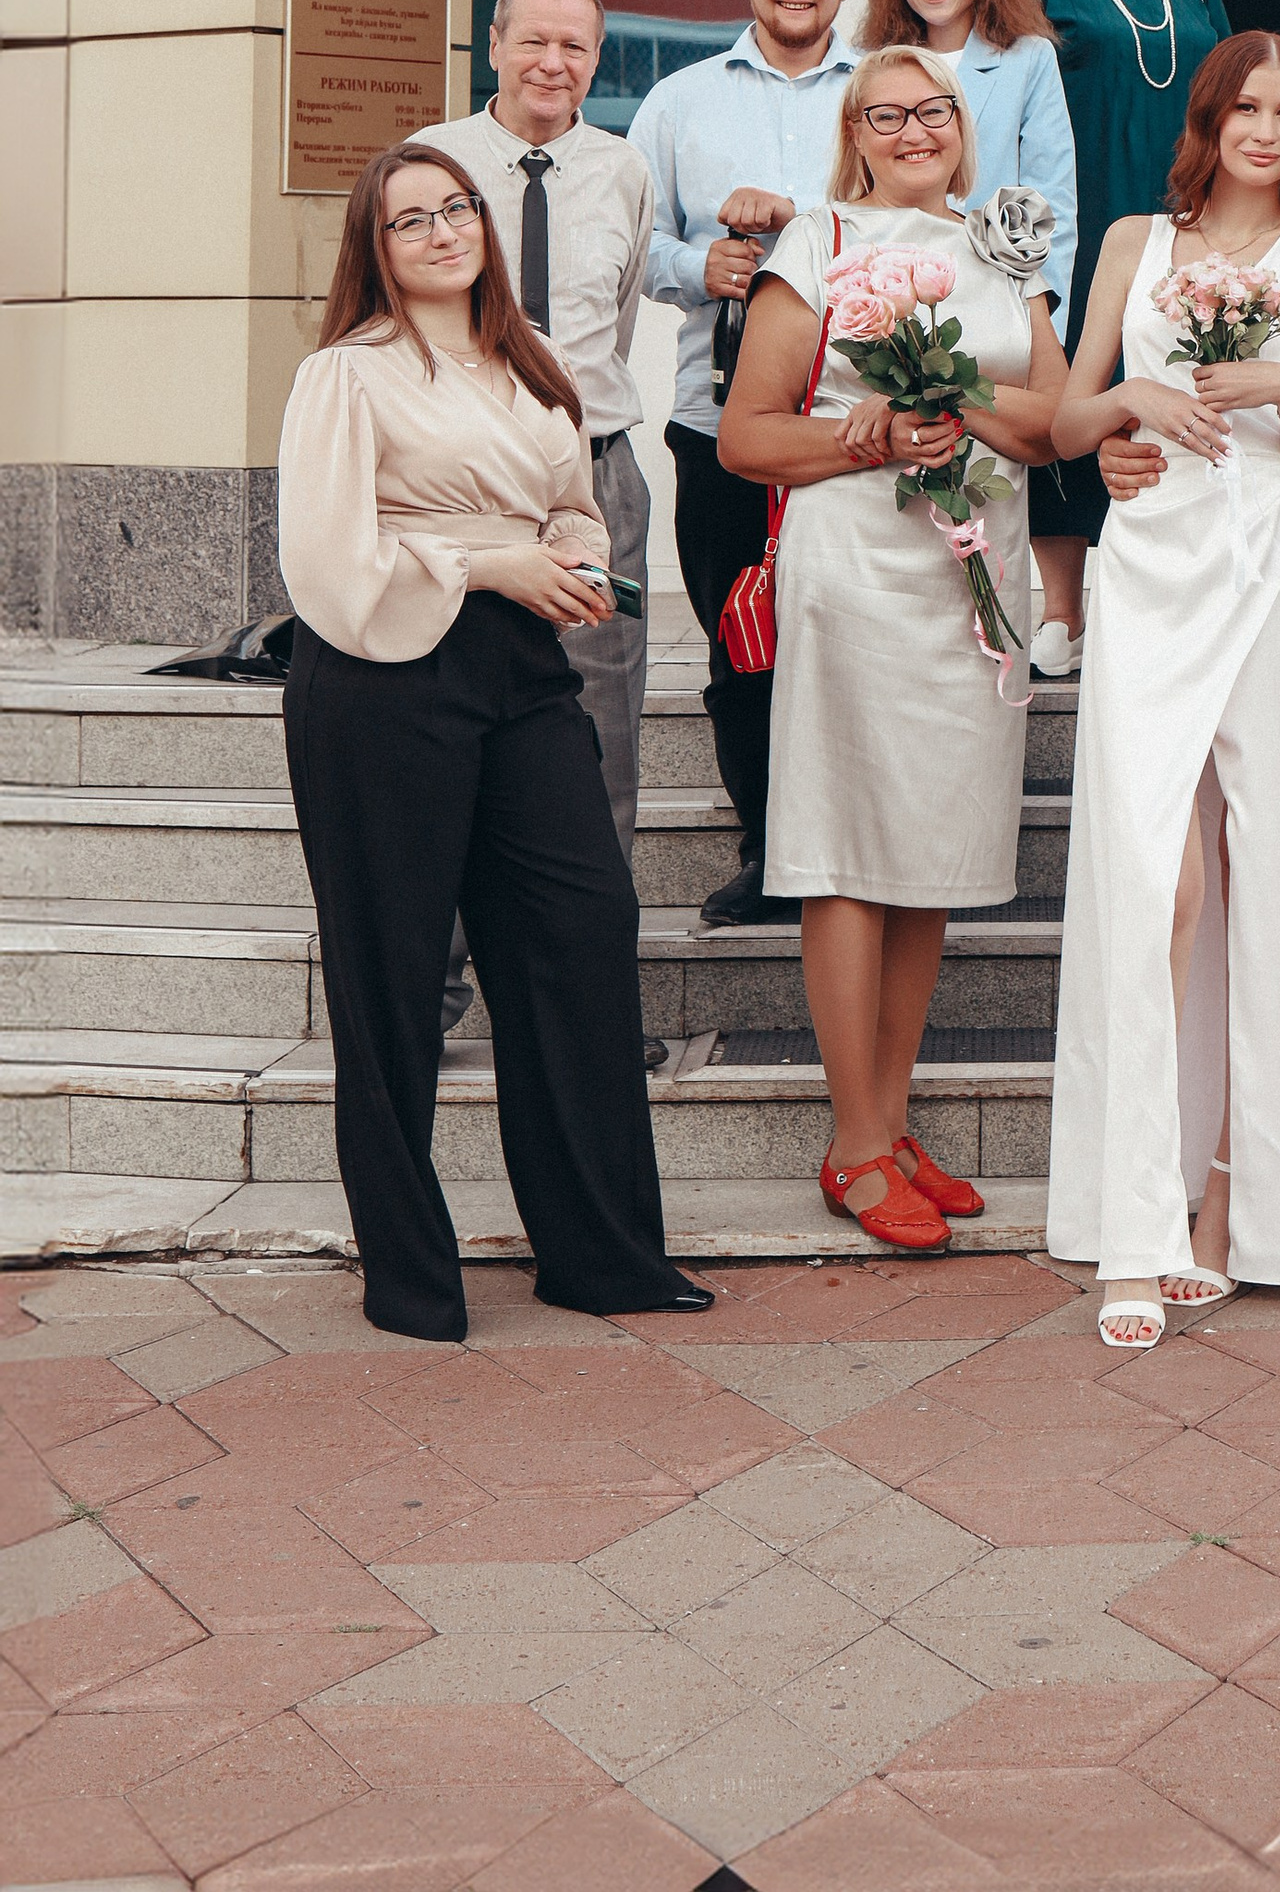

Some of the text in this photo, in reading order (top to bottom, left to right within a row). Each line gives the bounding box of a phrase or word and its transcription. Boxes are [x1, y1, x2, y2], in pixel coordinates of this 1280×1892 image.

[321, 77, 422, 95] РЕЖИМ РАБОТЫ:
[296, 113, 332, 125] Перерыв
